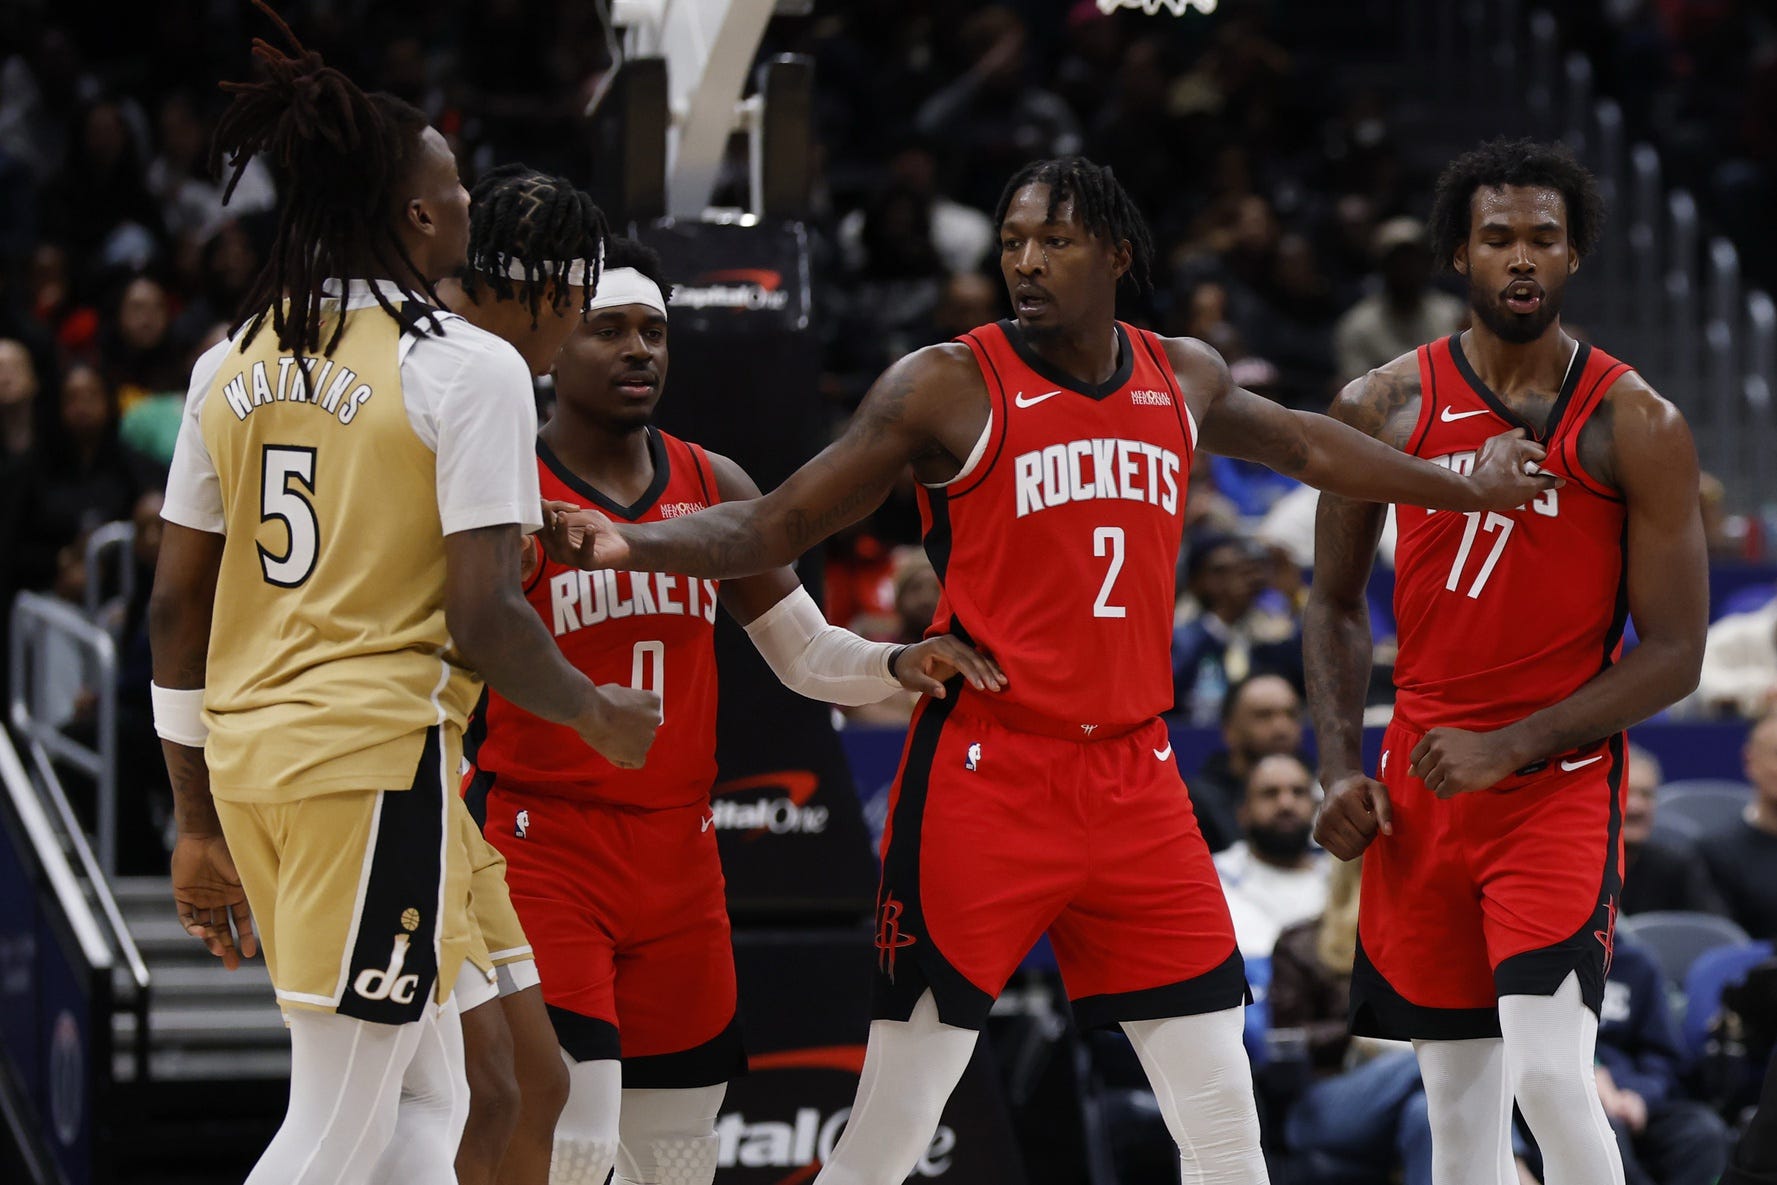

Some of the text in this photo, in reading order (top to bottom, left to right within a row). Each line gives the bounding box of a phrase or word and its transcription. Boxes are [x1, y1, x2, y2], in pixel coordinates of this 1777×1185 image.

[223, 356, 373, 425] WATKINS
[1131, 390, 1170, 399] MEMORIAL
[1132, 397, 1171, 406] HERMANN
[255, 444, 320, 588] 5
[660, 502, 705, 512] MEMORIAL
[1015, 438, 1180, 519] ROCKETS
[1093, 526, 1127, 618] 2
[1445, 511, 1515, 600] 17
[550, 568, 719, 637] ROCKETS
[631, 640, 665, 727] 0
